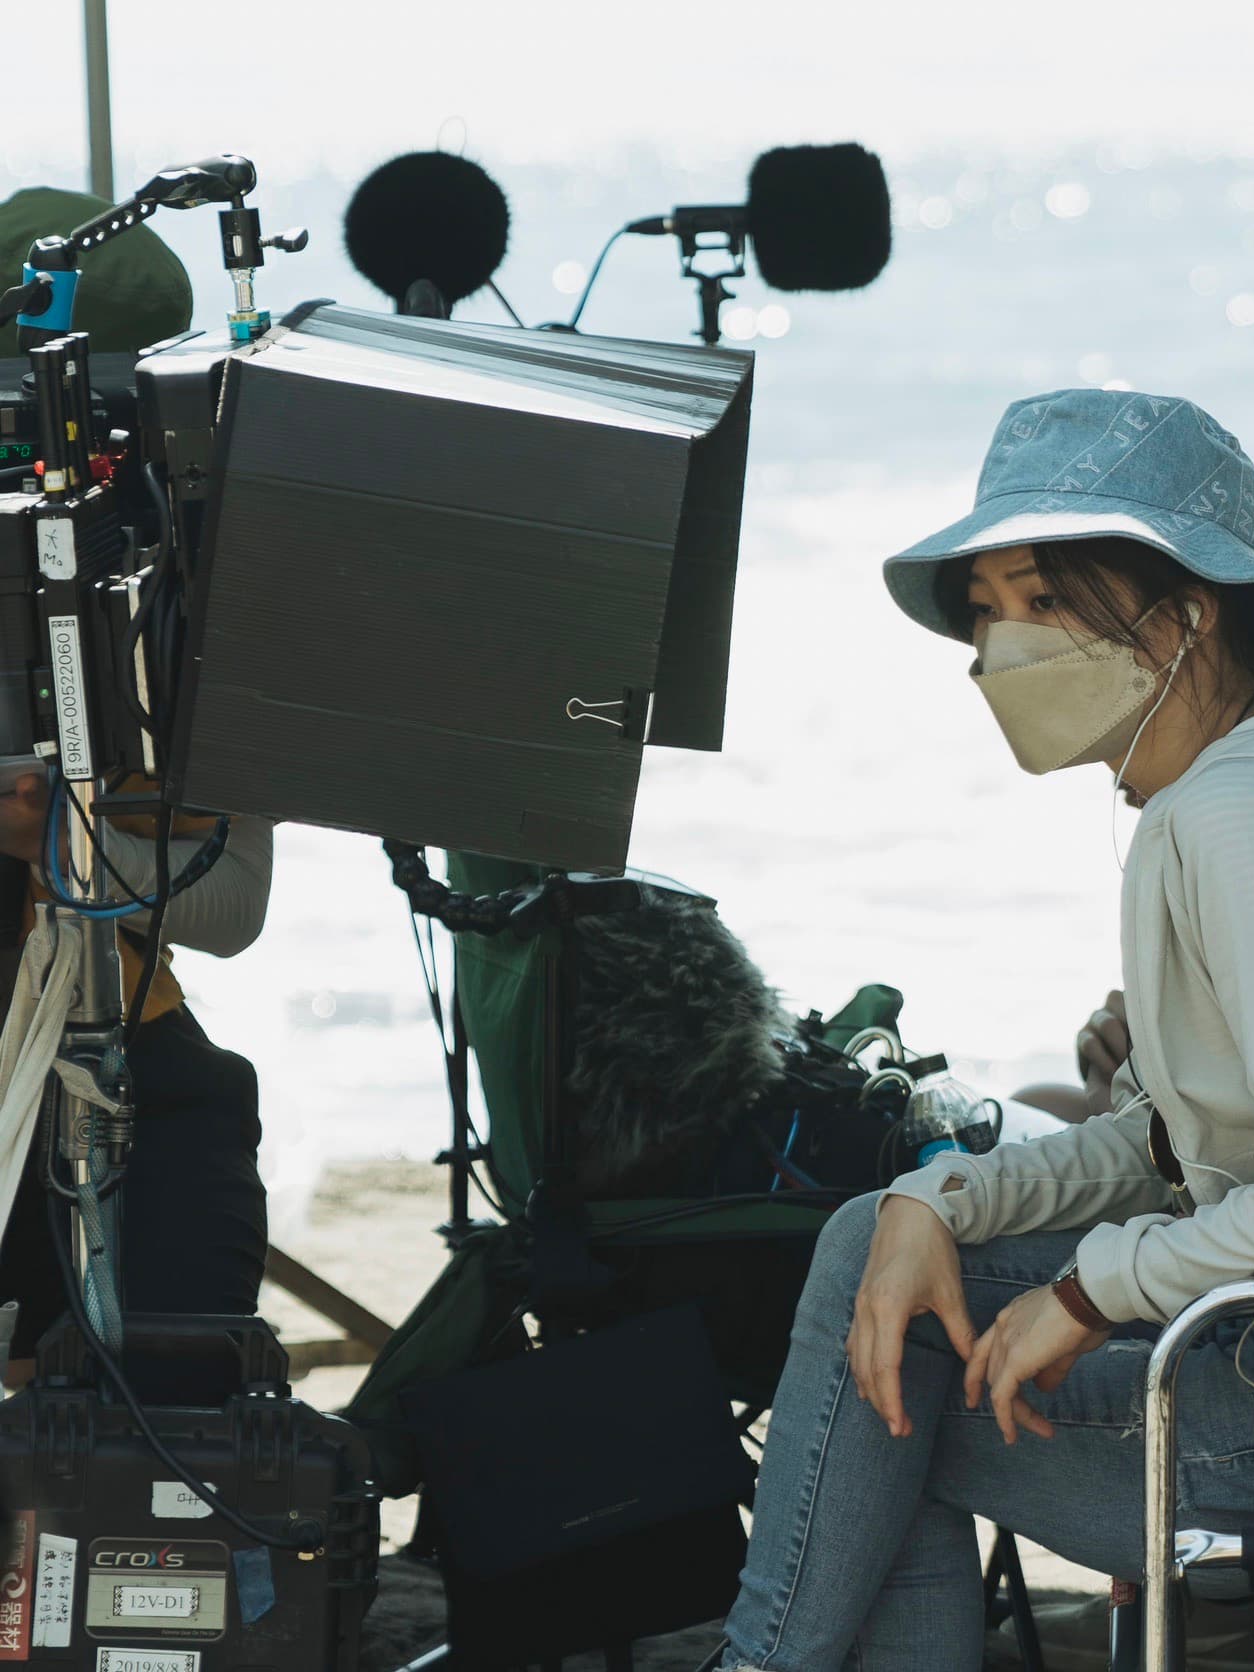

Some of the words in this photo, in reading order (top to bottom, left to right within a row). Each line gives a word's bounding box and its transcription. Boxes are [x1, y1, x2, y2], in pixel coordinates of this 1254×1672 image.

[56, 632, 82, 763] 9R/A-00522060
[130, 1595, 184, 1609] 12V-D1
[115, 1658, 179, 1672] 2019/8/8
